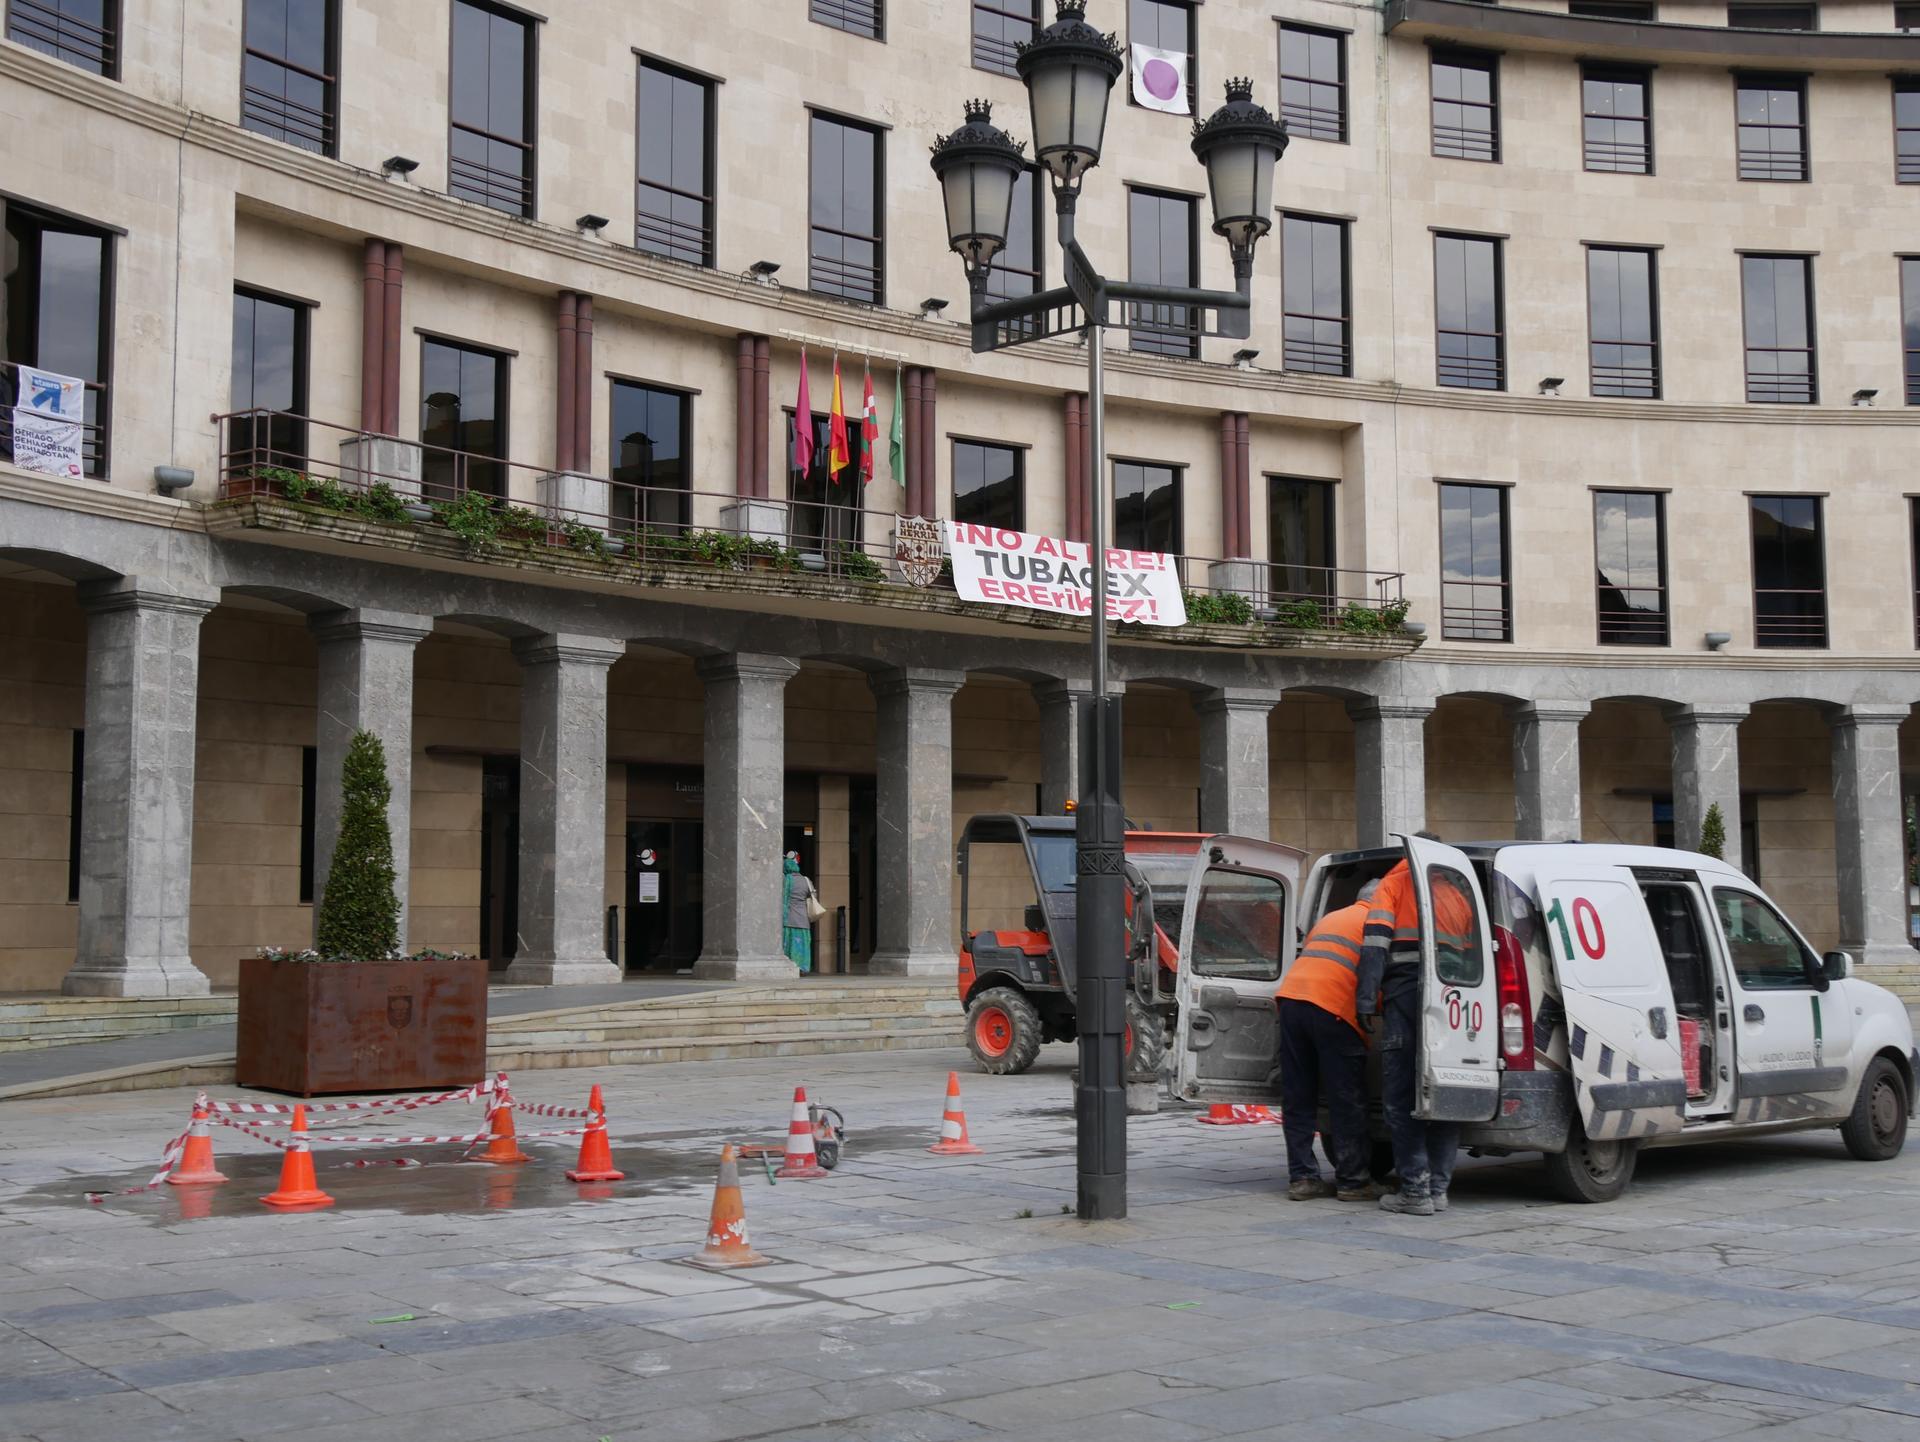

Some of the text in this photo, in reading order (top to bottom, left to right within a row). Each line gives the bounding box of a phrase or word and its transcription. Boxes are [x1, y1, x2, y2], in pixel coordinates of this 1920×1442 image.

[899, 519, 939, 532] EUSKAL
[900, 528, 938, 540] HERRIA
[1034, 537, 1077, 561] AL
[1546, 896, 1606, 961] 10
[1448, 999, 1482, 1032] 010
